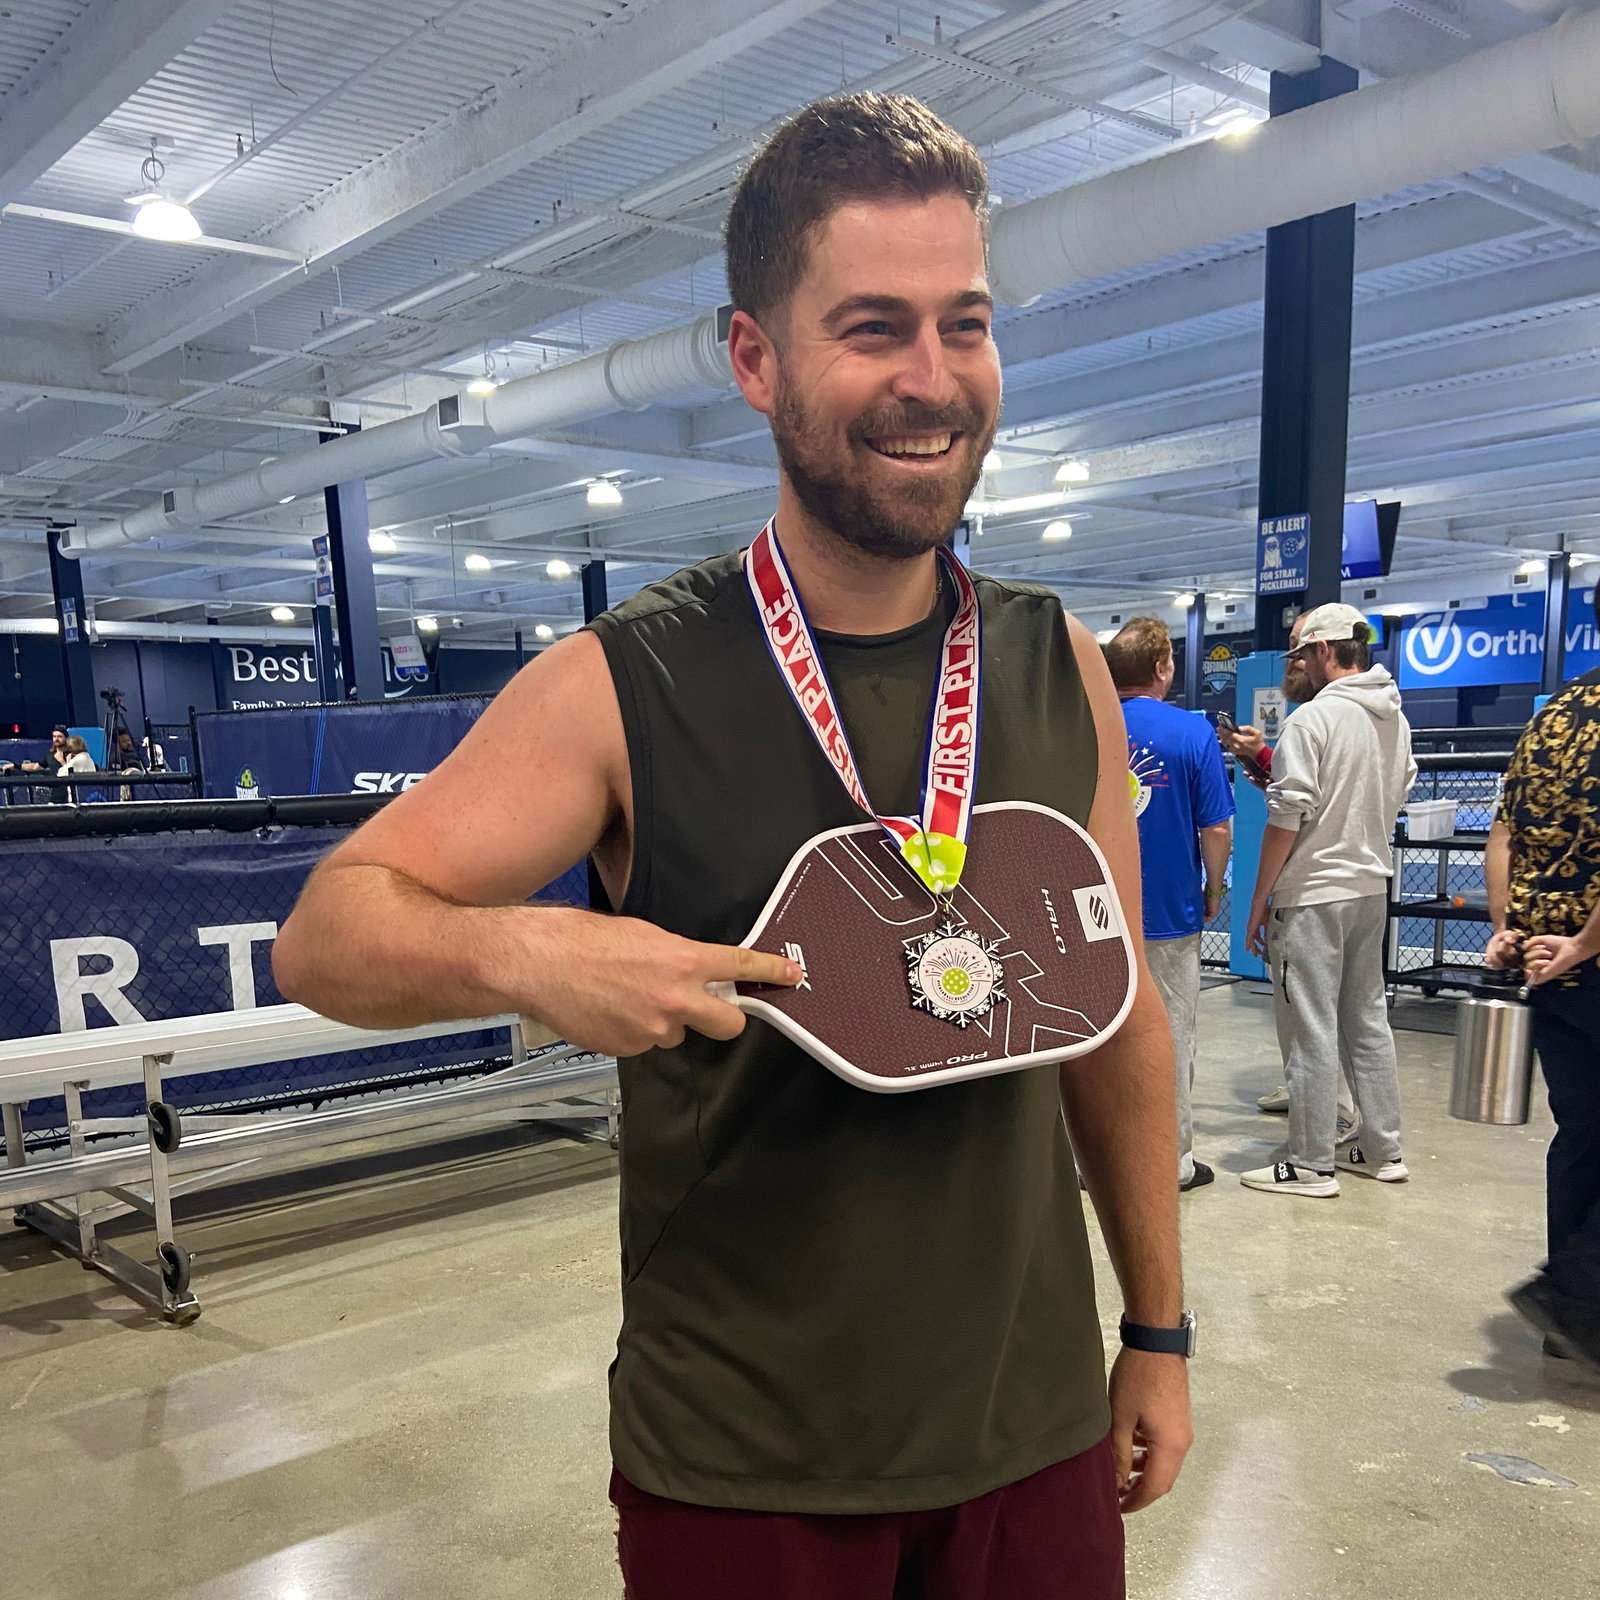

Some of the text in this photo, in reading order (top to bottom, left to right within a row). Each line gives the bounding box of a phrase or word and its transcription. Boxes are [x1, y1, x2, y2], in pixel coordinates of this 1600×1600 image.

[1261, 516, 1306, 535] BE ALERT
[1260, 568, 1297, 581] FOR STRAY
[1260, 577, 1304, 592] PICKLEBALLS
[228, 647, 317, 682] Best
[763, 589, 827, 717] PLACE
[932, 704, 972, 799] FIRST
[1040, 888, 1067, 955] HALO
[946, 1050, 988, 1065] PRO
